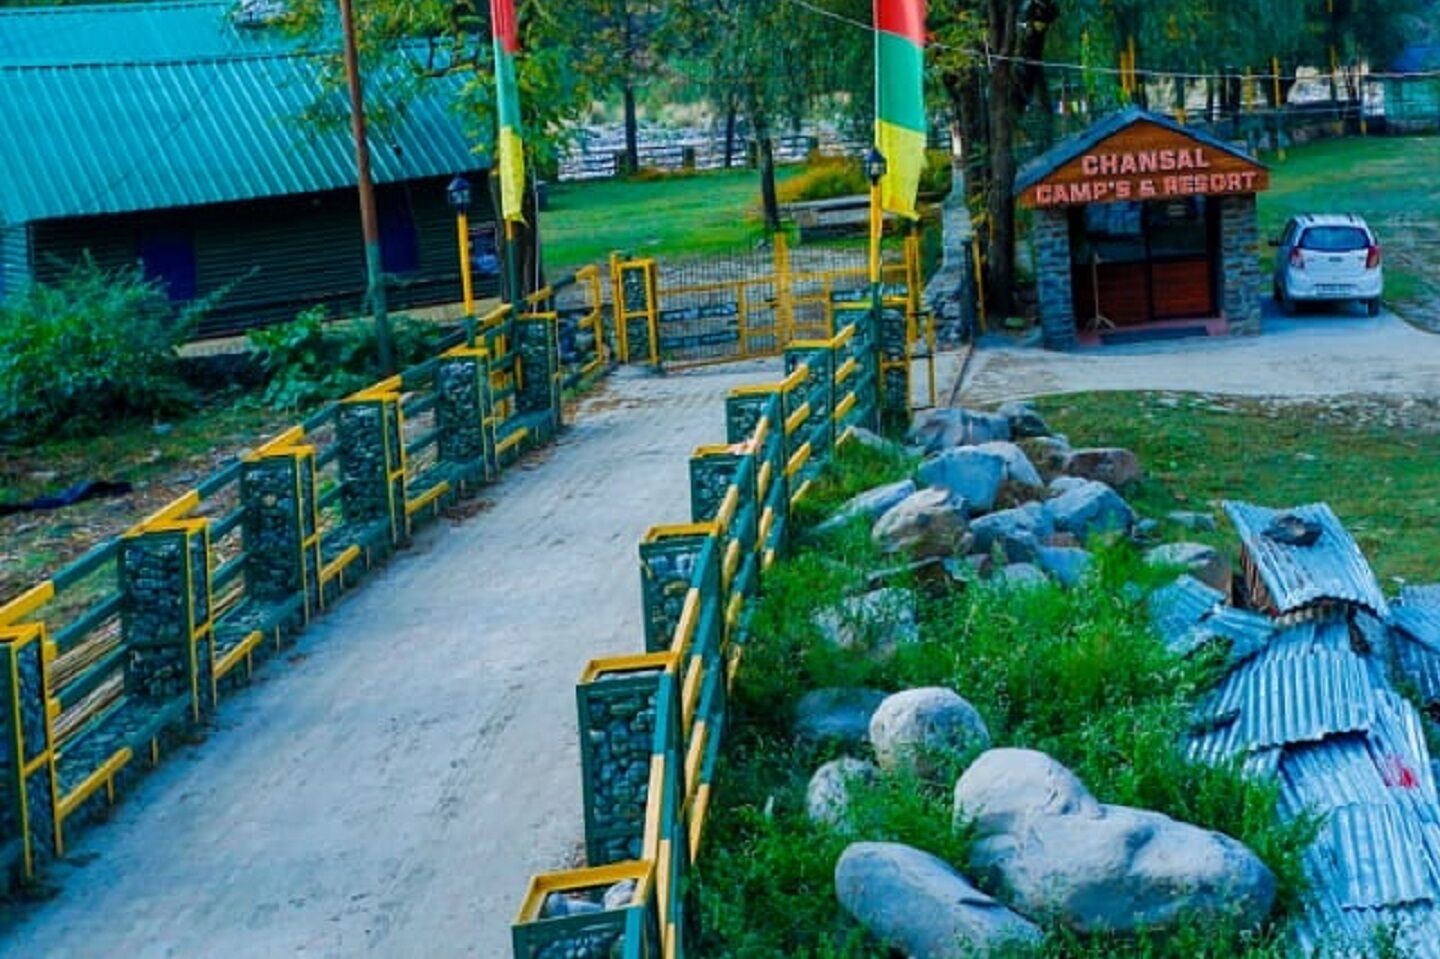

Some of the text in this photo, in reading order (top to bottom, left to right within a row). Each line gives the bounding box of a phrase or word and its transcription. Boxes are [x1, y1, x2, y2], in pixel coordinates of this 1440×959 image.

[1081, 149, 1211, 176] CHANSAL
[1139, 181, 1156, 196] &
[1162, 171, 1257, 195] RESORT
